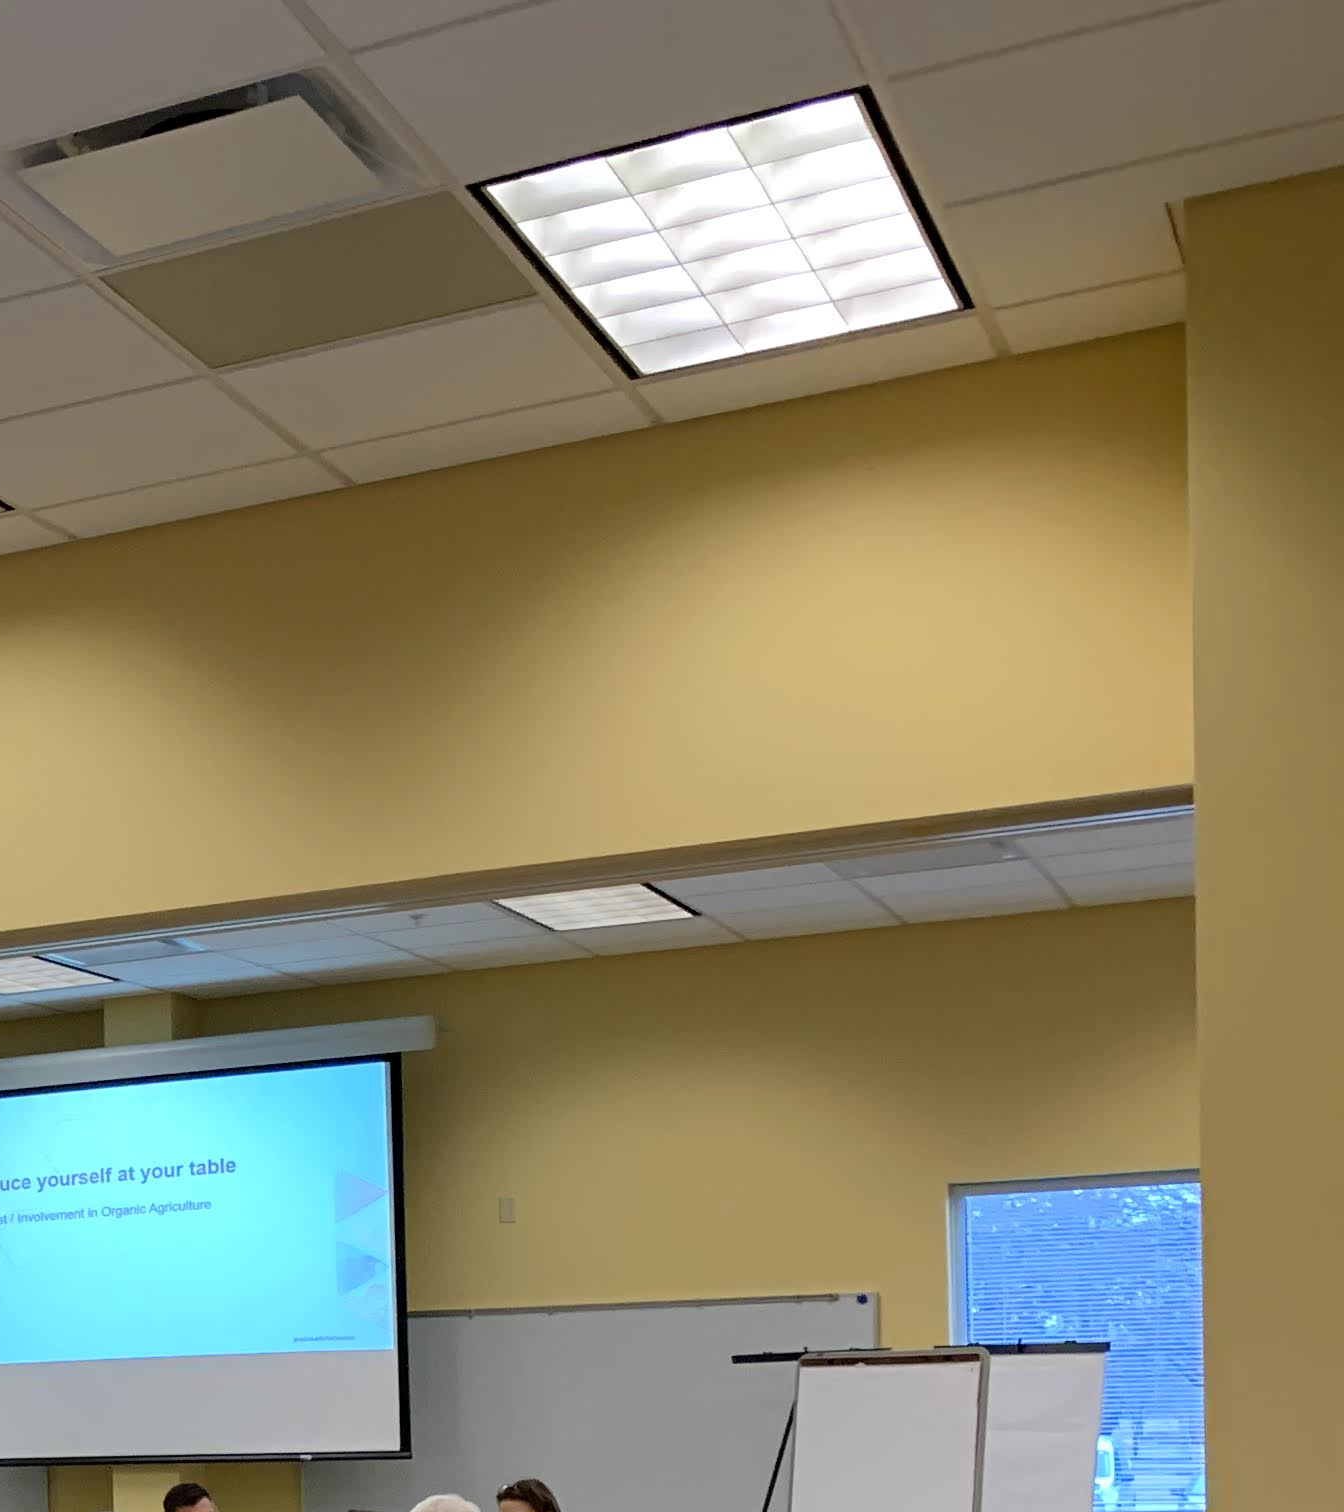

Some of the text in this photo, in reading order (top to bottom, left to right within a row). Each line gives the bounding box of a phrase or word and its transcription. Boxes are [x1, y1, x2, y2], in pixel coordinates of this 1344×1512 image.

[37, 1167, 113, 1193] yourself
[117, 1166, 136, 1182] at
[140, 1163, 184, 1185] your
[189, 1157, 237, 1176] table
[17, 1208, 86, 1224] Involvement
[101, 1205, 147, 1219] Organic
[148, 1200, 212, 1216] Agriculture
